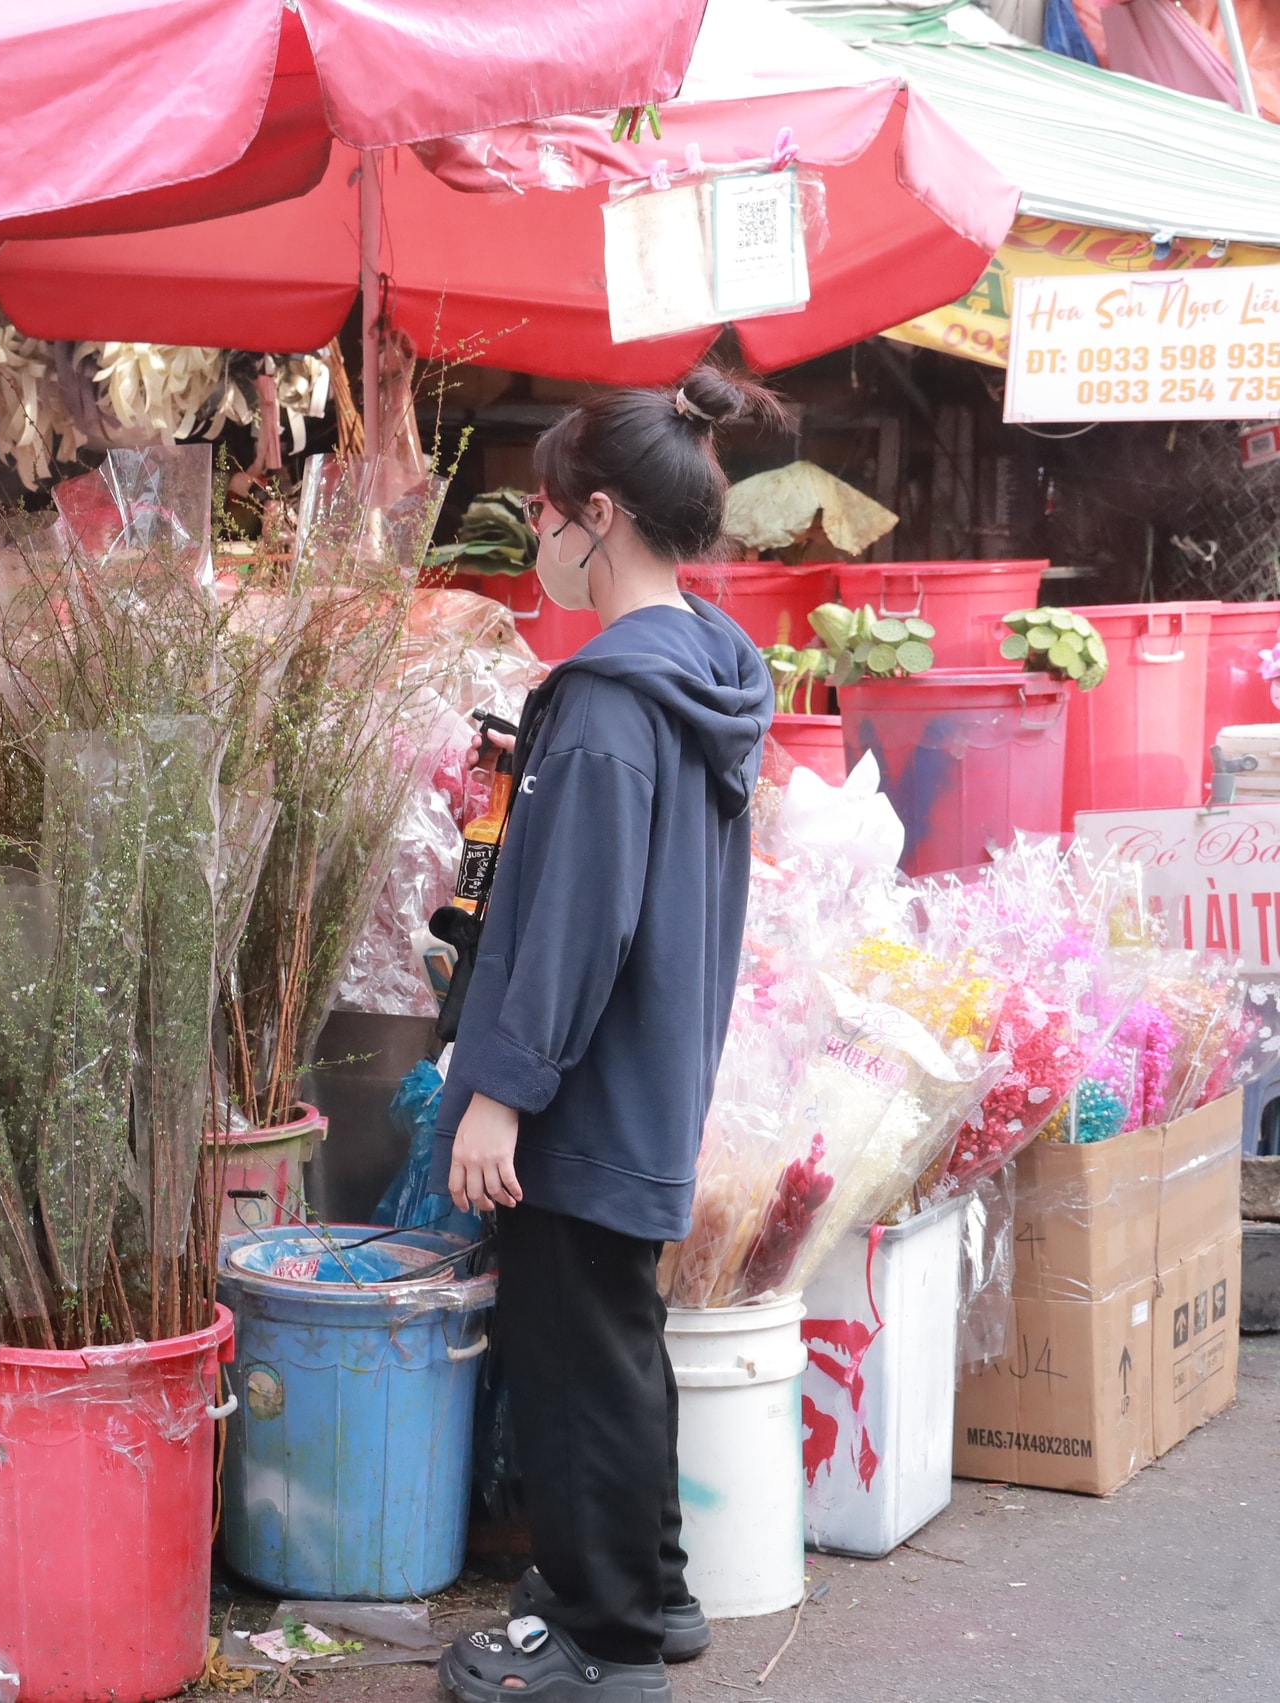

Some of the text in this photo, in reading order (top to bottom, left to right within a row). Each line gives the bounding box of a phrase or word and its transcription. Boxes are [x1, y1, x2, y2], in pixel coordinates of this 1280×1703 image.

[1026, 290, 1083, 333] Hoa
[1095, 288, 1147, 329] Sen
[1157, 283, 1228, 330] Ngọc
[1026, 342, 1280, 374] ĐT: 0933 598 935
[1077, 376, 1280, 405] 0933 254 735
[967, 1427, 1093, 1458] MEAS:74X48X28CM
